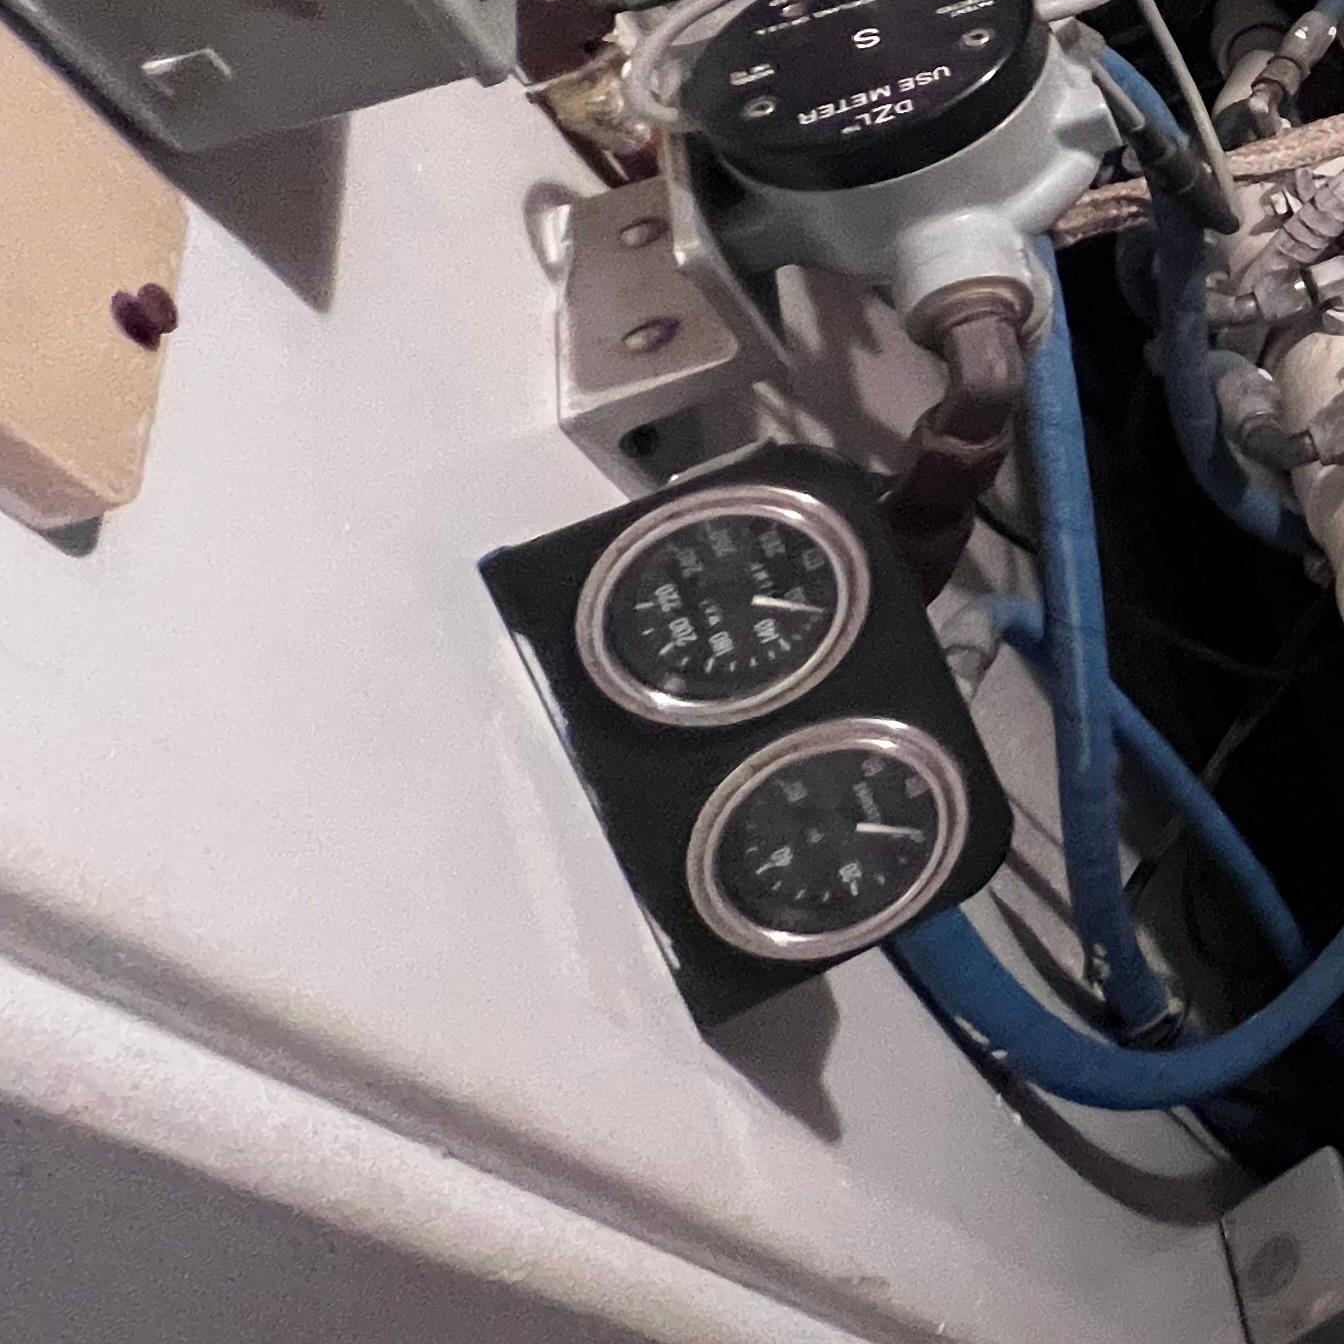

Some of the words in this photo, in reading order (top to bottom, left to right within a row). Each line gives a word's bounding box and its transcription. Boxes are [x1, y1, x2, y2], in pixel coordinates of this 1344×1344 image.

[852, 27, 881, 50] S
[898, 65, 951, 93] USE
[797, 84, 891, 126] METER
